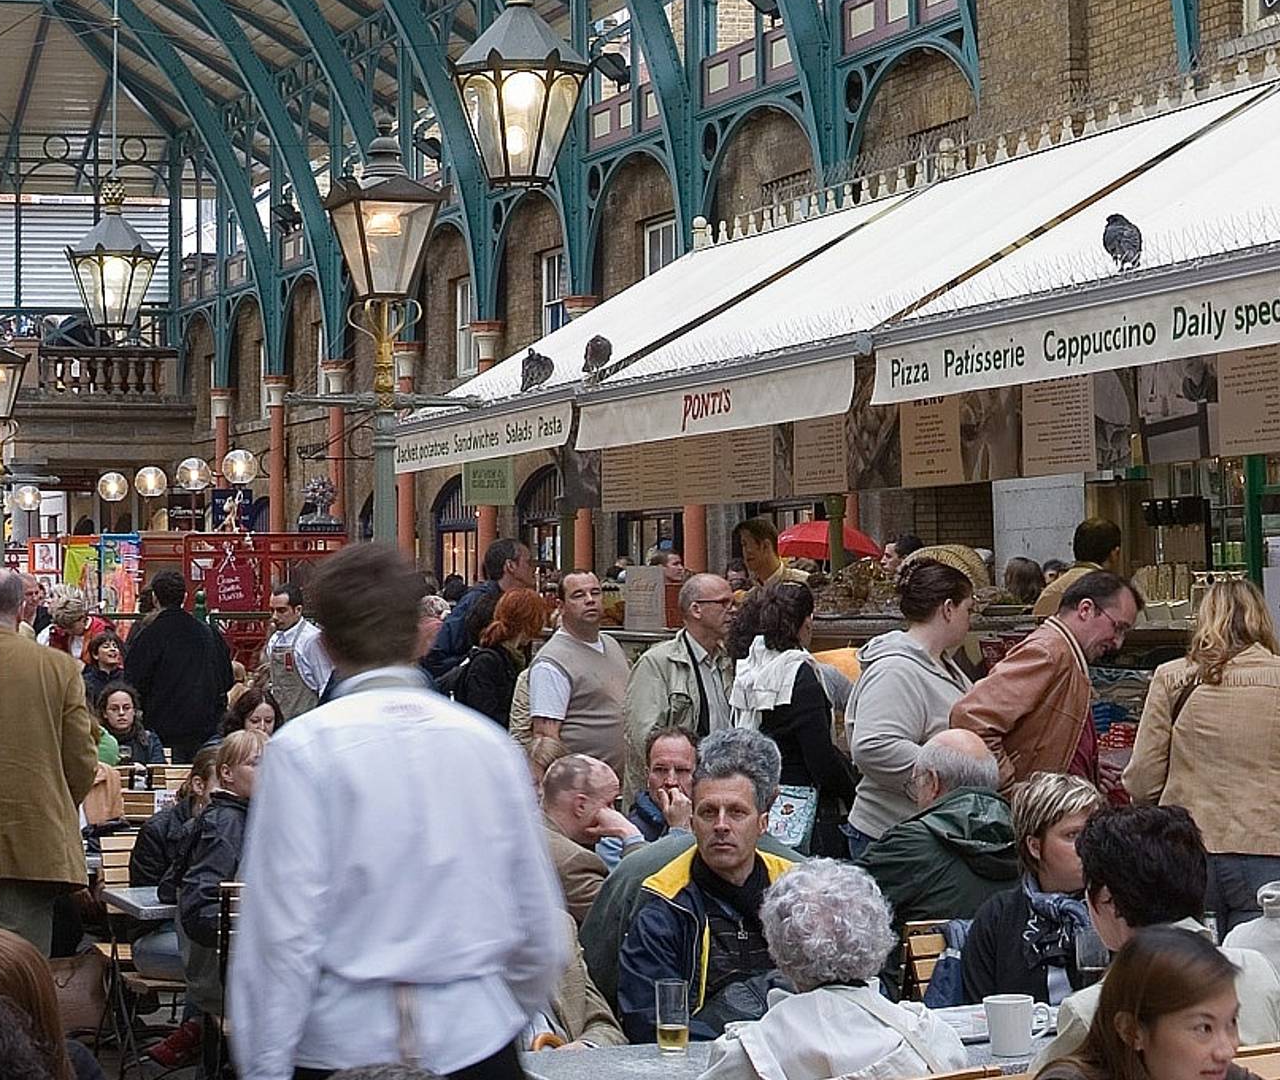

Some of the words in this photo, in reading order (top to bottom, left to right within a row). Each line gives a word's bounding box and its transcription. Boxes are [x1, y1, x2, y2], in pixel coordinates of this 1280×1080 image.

[890, 357, 930, 388] Pizza
[943, 337, 1025, 379] Patisserie
[1042, 315, 1156, 366] Cappuccino
[1172, 301, 1226, 340] Daily
[681, 388, 731, 432] PONTI'S
[396, 441, 420, 463] Jacket
[420, 439, 449, 464] potatoes
[453, 429, 499, 453] Sandwiches
[505, 419, 533, 444] Salads
[537, 415, 563, 438] Pasta
